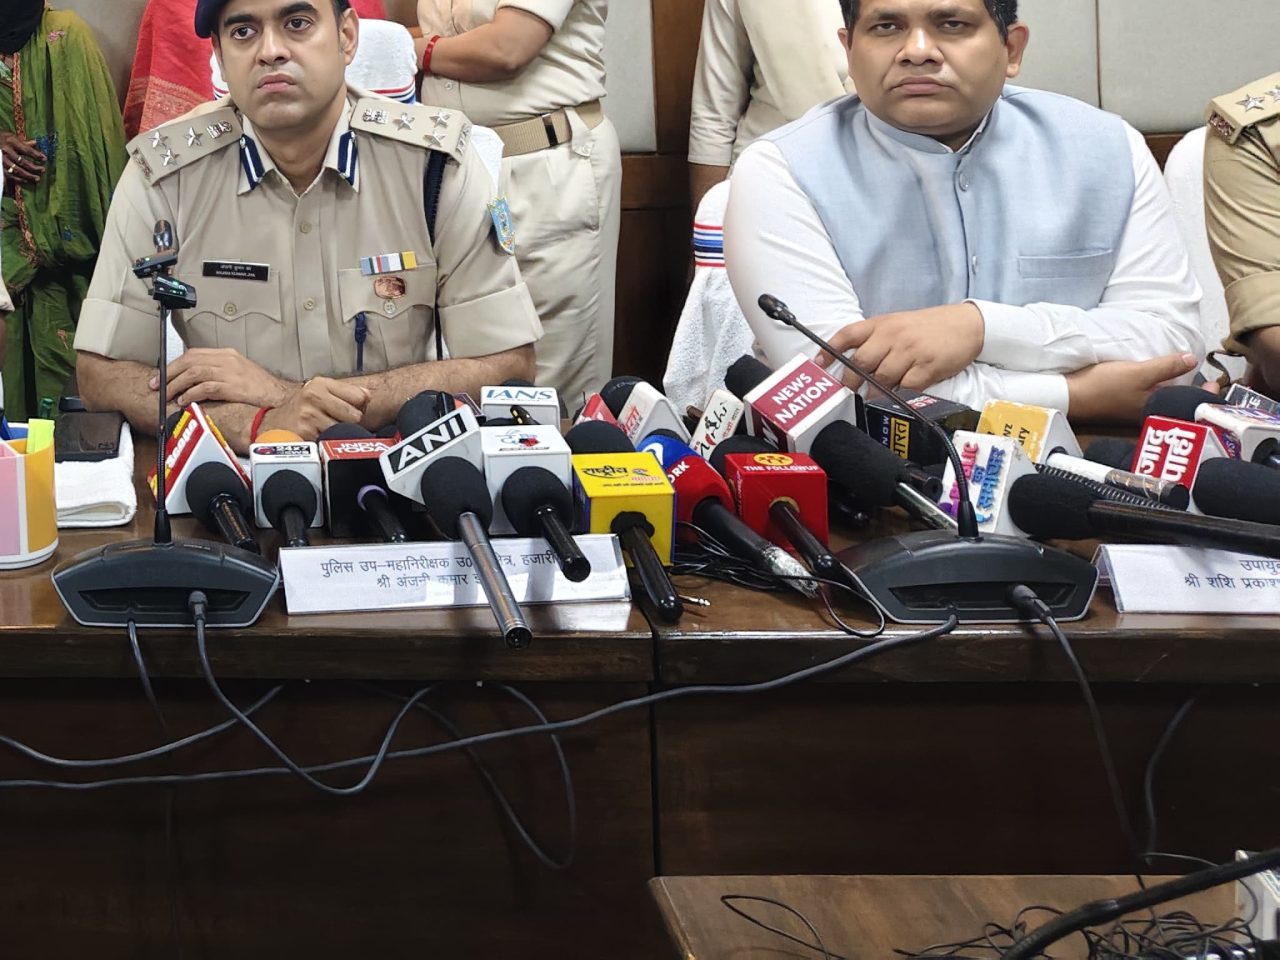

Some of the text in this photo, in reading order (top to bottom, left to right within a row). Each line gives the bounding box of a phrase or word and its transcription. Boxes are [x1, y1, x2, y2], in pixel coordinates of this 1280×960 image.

[486, 389, 554, 400] IANS
[772, 372, 813, 405] NEWS
[774, 377, 834, 424] NATION
[396, 413, 467, 470] ANI
[1161, 427, 1196, 481] पाही
[320, 558, 354, 578] पुलिस
[520, 551, 557, 566] हजारी
[376, 574, 391, 589] श्री
[1184, 572, 1201, 587] श्री
[1205, 573, 1236, 588] शशि
